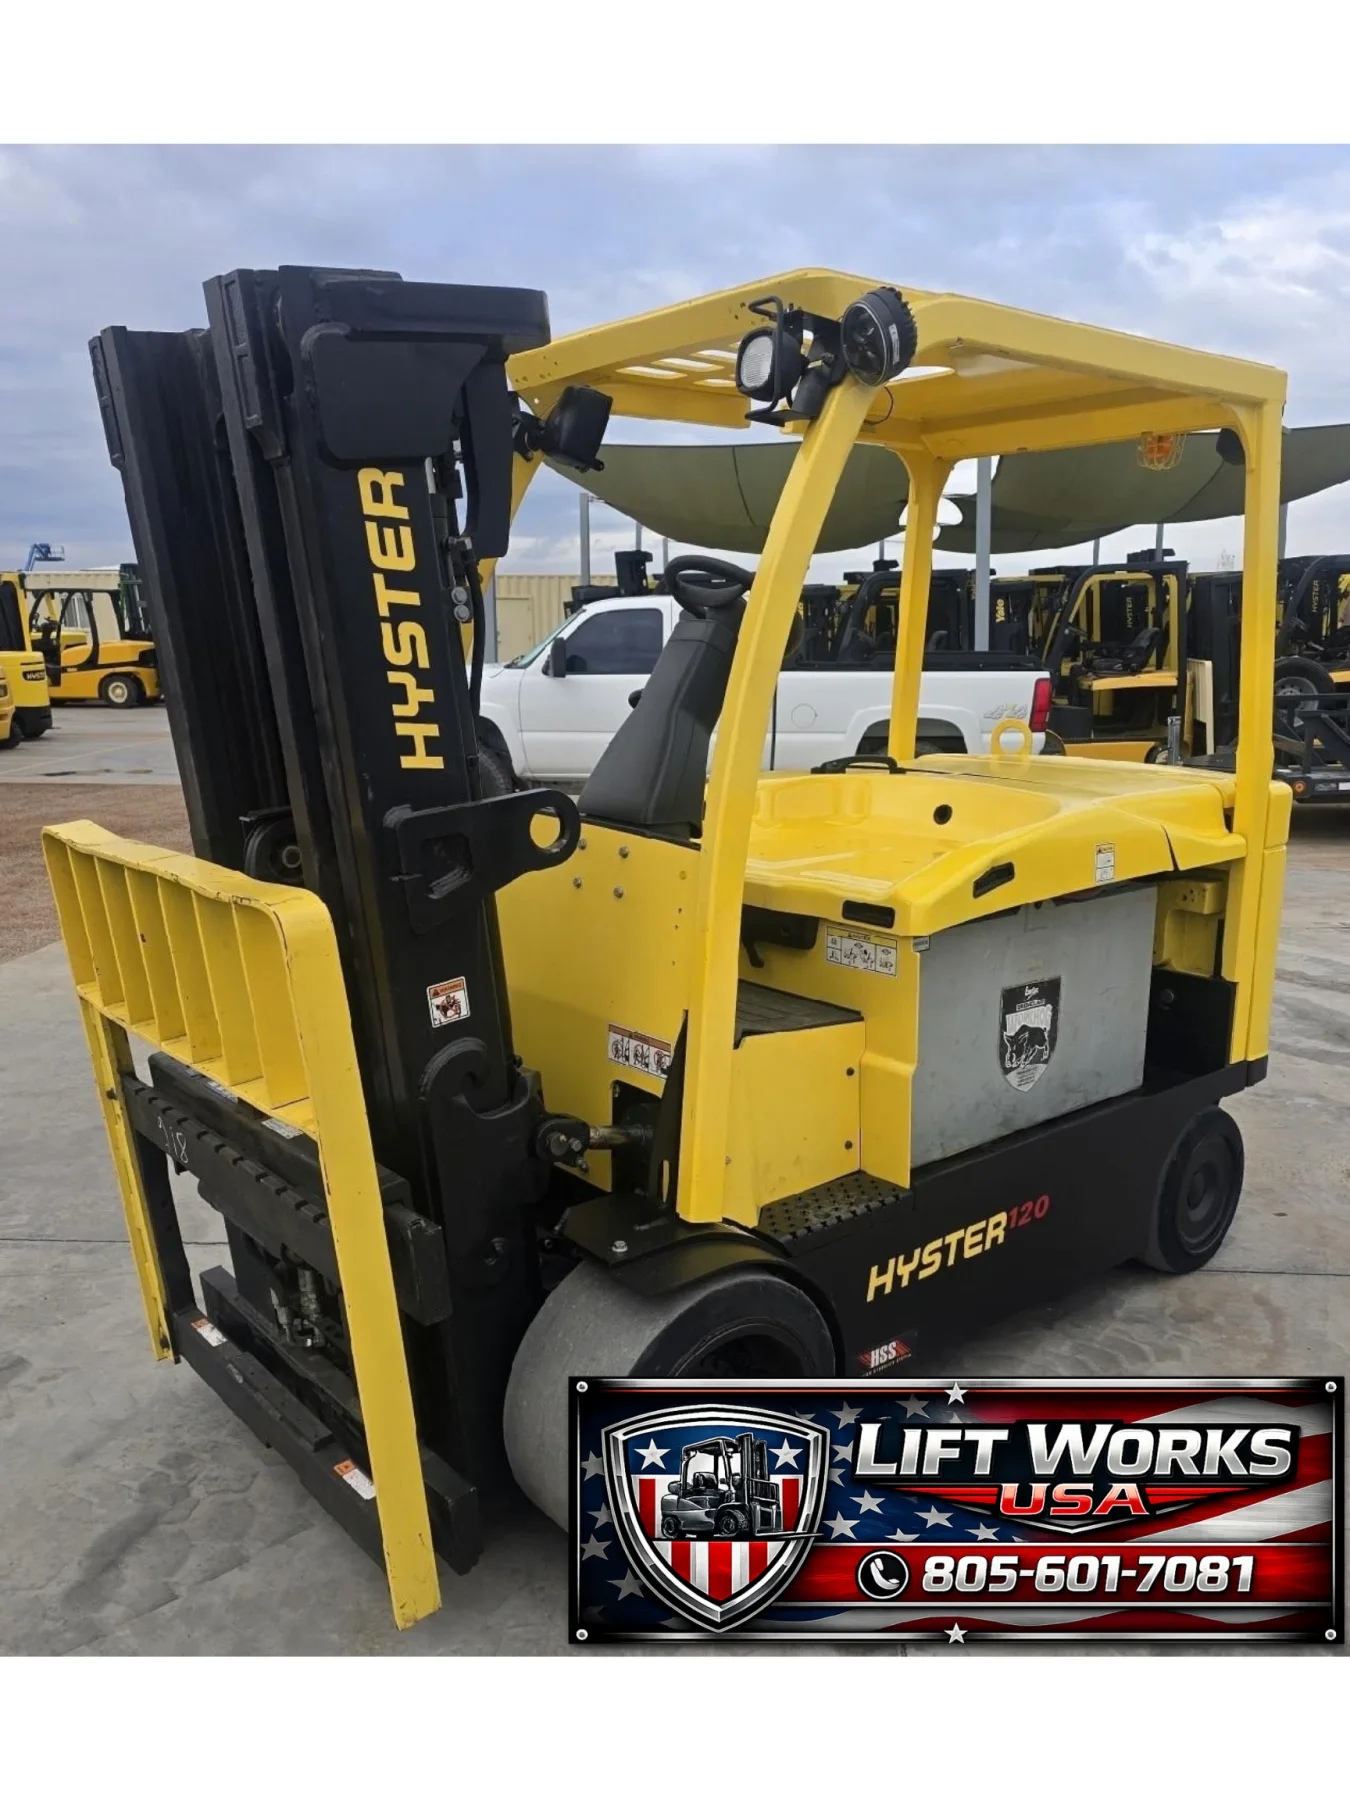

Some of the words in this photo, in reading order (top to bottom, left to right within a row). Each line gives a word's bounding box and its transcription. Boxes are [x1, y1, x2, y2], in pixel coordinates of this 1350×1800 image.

[357, 467, 445, 769] HYSTER
[1311, 580, 1320, 613] HYSTER
[866, 1211, 1008, 1303] HYSTER
[1009, 1195, 1050, 1229] 120
[870, 1341, 897, 1369] HSS
